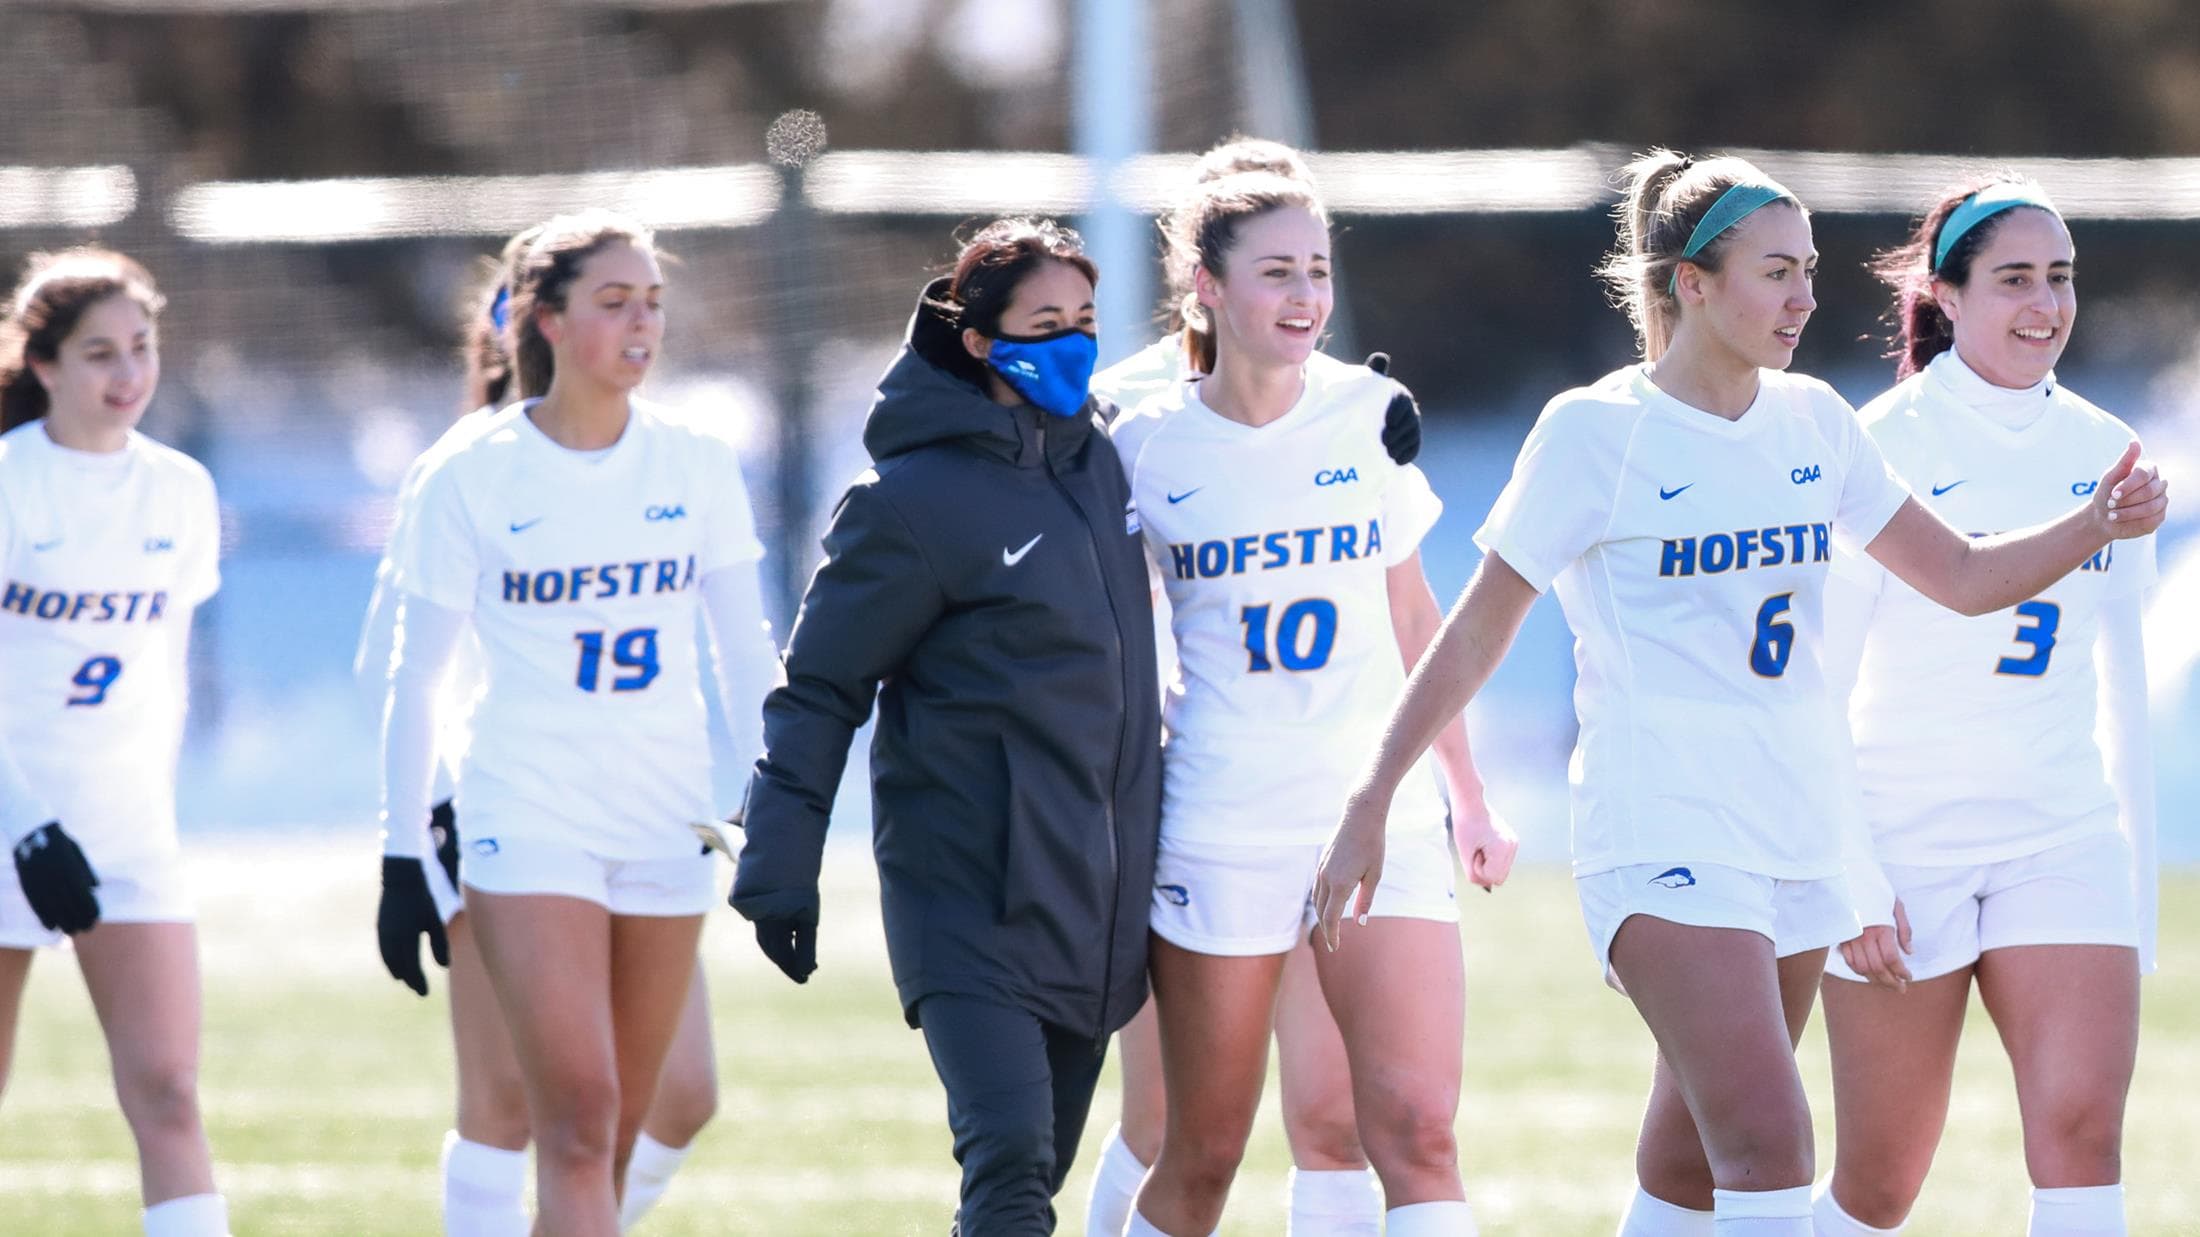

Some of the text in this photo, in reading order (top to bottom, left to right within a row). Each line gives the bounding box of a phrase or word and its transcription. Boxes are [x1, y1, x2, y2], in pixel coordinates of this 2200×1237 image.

[1314, 467, 1358, 486] CAA
[1791, 464, 1822, 484] CAA
[2071, 481, 2098, 496] CA
[1168, 518, 1382, 580] HOFSTRA
[1659, 521, 1833, 577] HOFSTR
[573, 626, 662, 694] 19
[1239, 597, 1339, 674] 10
[1748, 591, 1795, 679] 6
[1993, 600, 2063, 679] 3
[66, 654, 122, 707] 9
